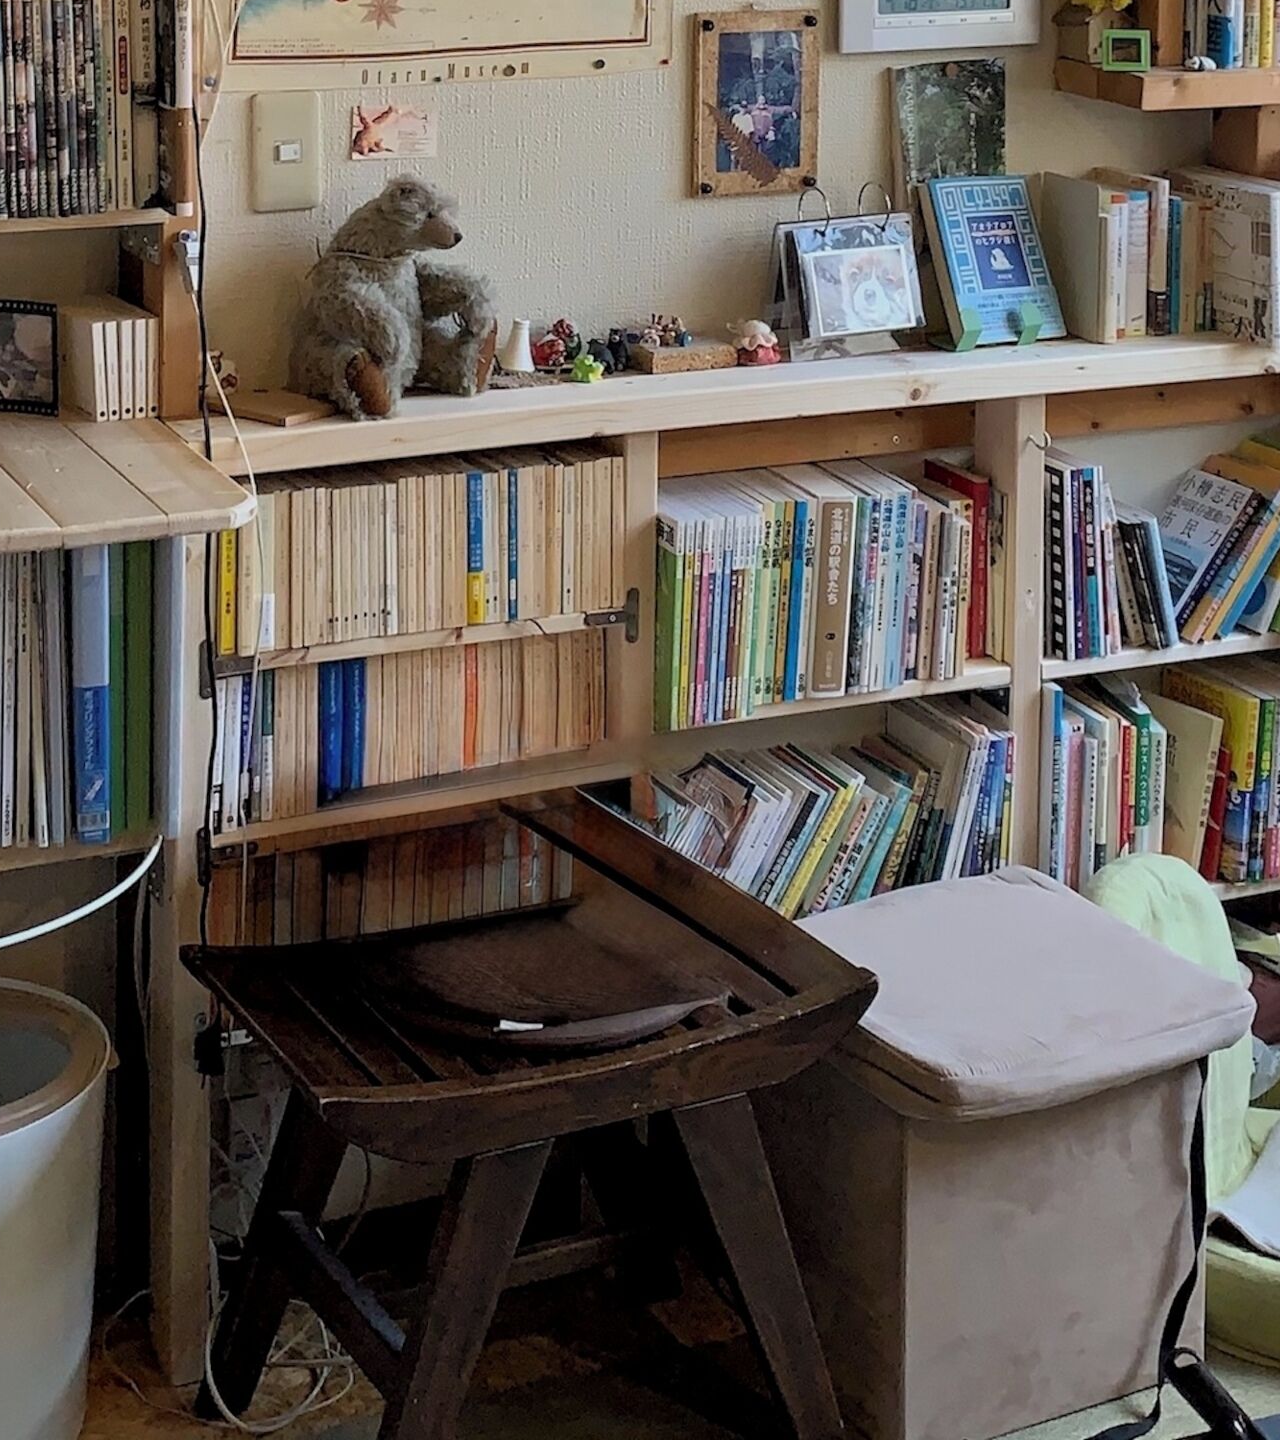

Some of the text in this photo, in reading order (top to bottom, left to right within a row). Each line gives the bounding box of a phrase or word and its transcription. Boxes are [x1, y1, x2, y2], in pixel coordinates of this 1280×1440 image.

[361, 61, 530, 85] Otaru Musem
[1183, 474, 1247, 513] 小樽志民
[828, 506, 843, 606] 北海道の駅舎たち
[1137, 726, 1150, 826] 全国ゲストハウスガイド
